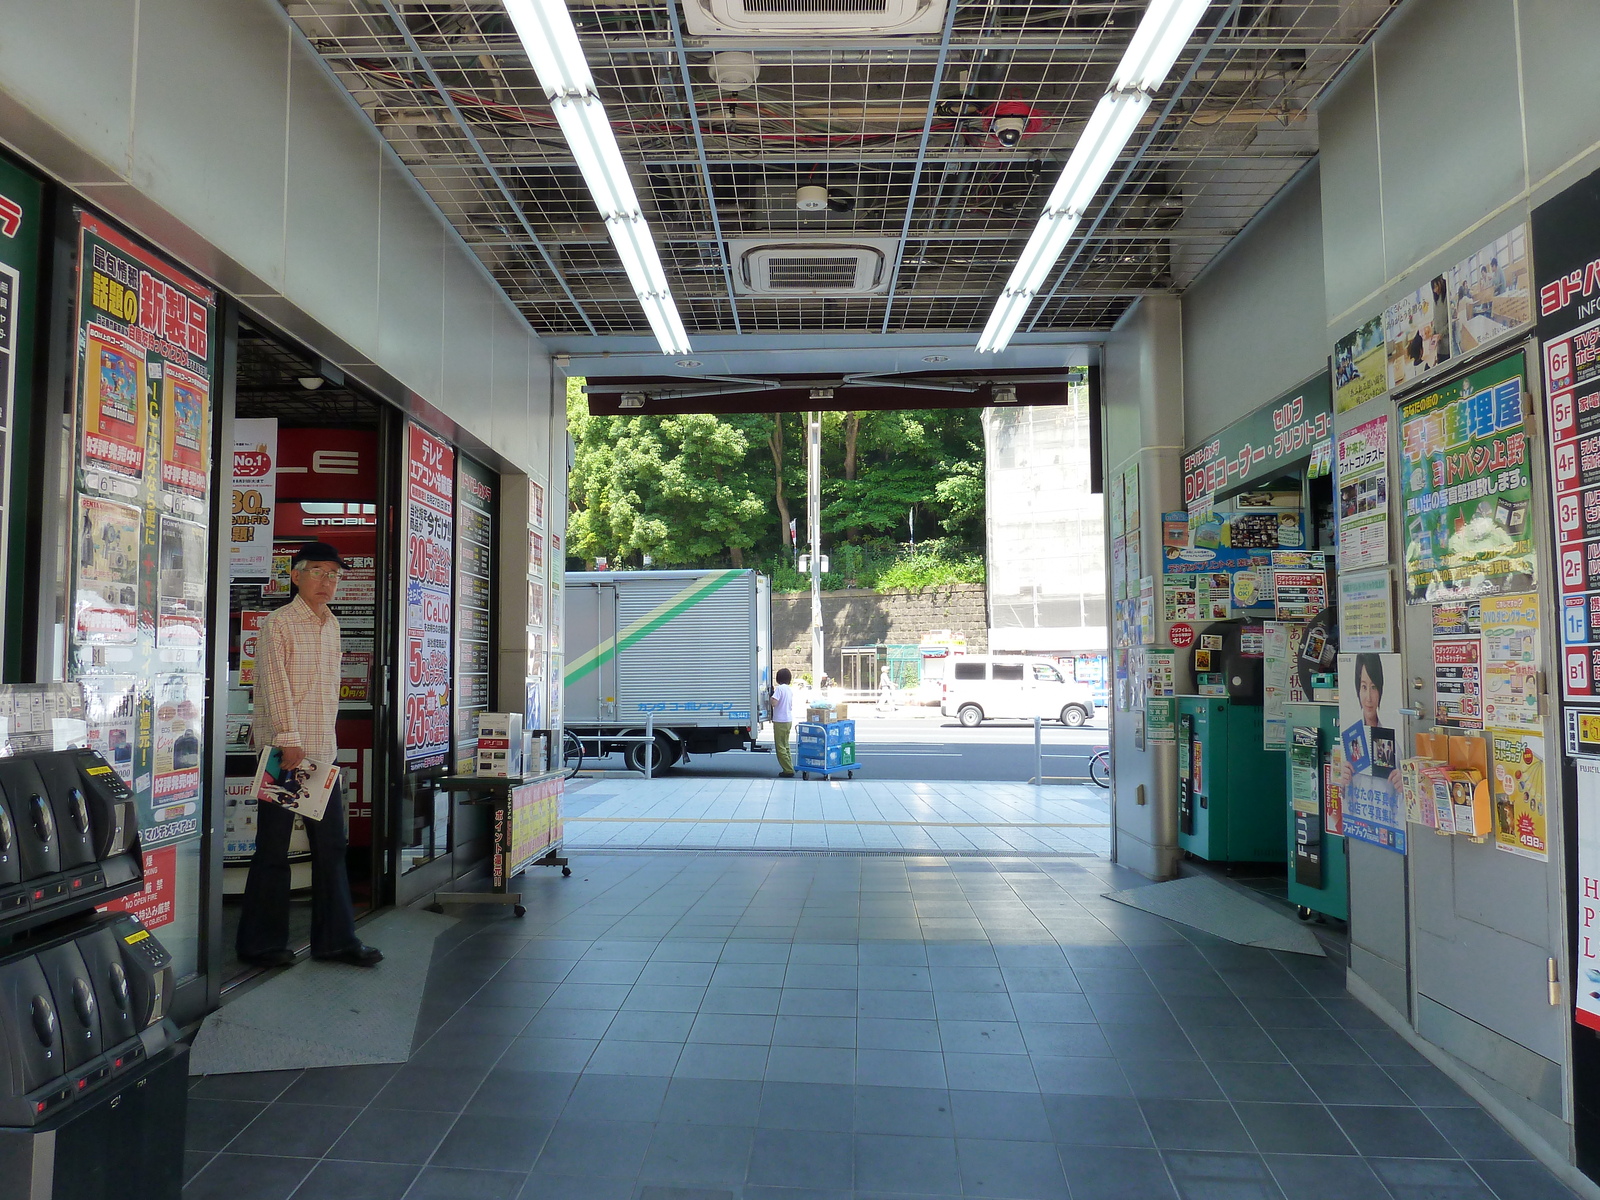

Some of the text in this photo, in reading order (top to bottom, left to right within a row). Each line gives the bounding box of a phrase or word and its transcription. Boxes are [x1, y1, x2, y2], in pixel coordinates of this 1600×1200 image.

[92, 271, 138, 324] 話題の
[139, 270, 207, 361] 新製品
[1551, 353, 1569, 372] 6F
[1272, 396, 1304, 432] セルフ
[1402, 375, 1523, 463] 写真整理屋
[1555, 403, 1571, 422] 5F
[86, 435, 142, 466] 好評発売中!!
[422, 438, 443, 471] テレビ
[1184, 438, 1220, 473] ヨドバシカメラ
[1431, 432, 1526, 488] ヨドバシ上野
[234, 455, 262, 467] No.1
[1339, 450, 1384, 475] フォトコンテスト
[1558, 454, 1574, 471] 4F
[1406, 467, 1527, 517] 思い出の写真整理致します。
[302, 518, 377, 526] EMOBIL
[1561, 504, 1577, 523] 3F
[162, 520, 179, 528] SONY
[428, 511, 452, 541] 今だけ!!
[409, 533, 435, 585] 20%
[1565, 559, 1581, 577] 2F
[1305, 605, 1319, 614] 15
[1568, 614, 1583, 633] 1F
[1172, 637, 1192, 645] キレイ
[409, 638, 430, 686] 5%
[1570, 660, 1584, 679] B1
[1462, 666, 1480, 680] 23円
[1463, 682, 1480, 695] 19円
[637, 701, 733, 712] カンダ コーポレーション
[406, 694, 435, 748] 25%
[1494, 750, 1522, 764] ストラップ
[154, 774, 199, 796] 好評発売中!!
[493, 809, 504, 887] ポイント還元!!
[1521, 834, 1545, 850] 498円
[125, 892, 158, 909] NO OPEN FIRE
[149, 914, 168, 926] OBJECTS
